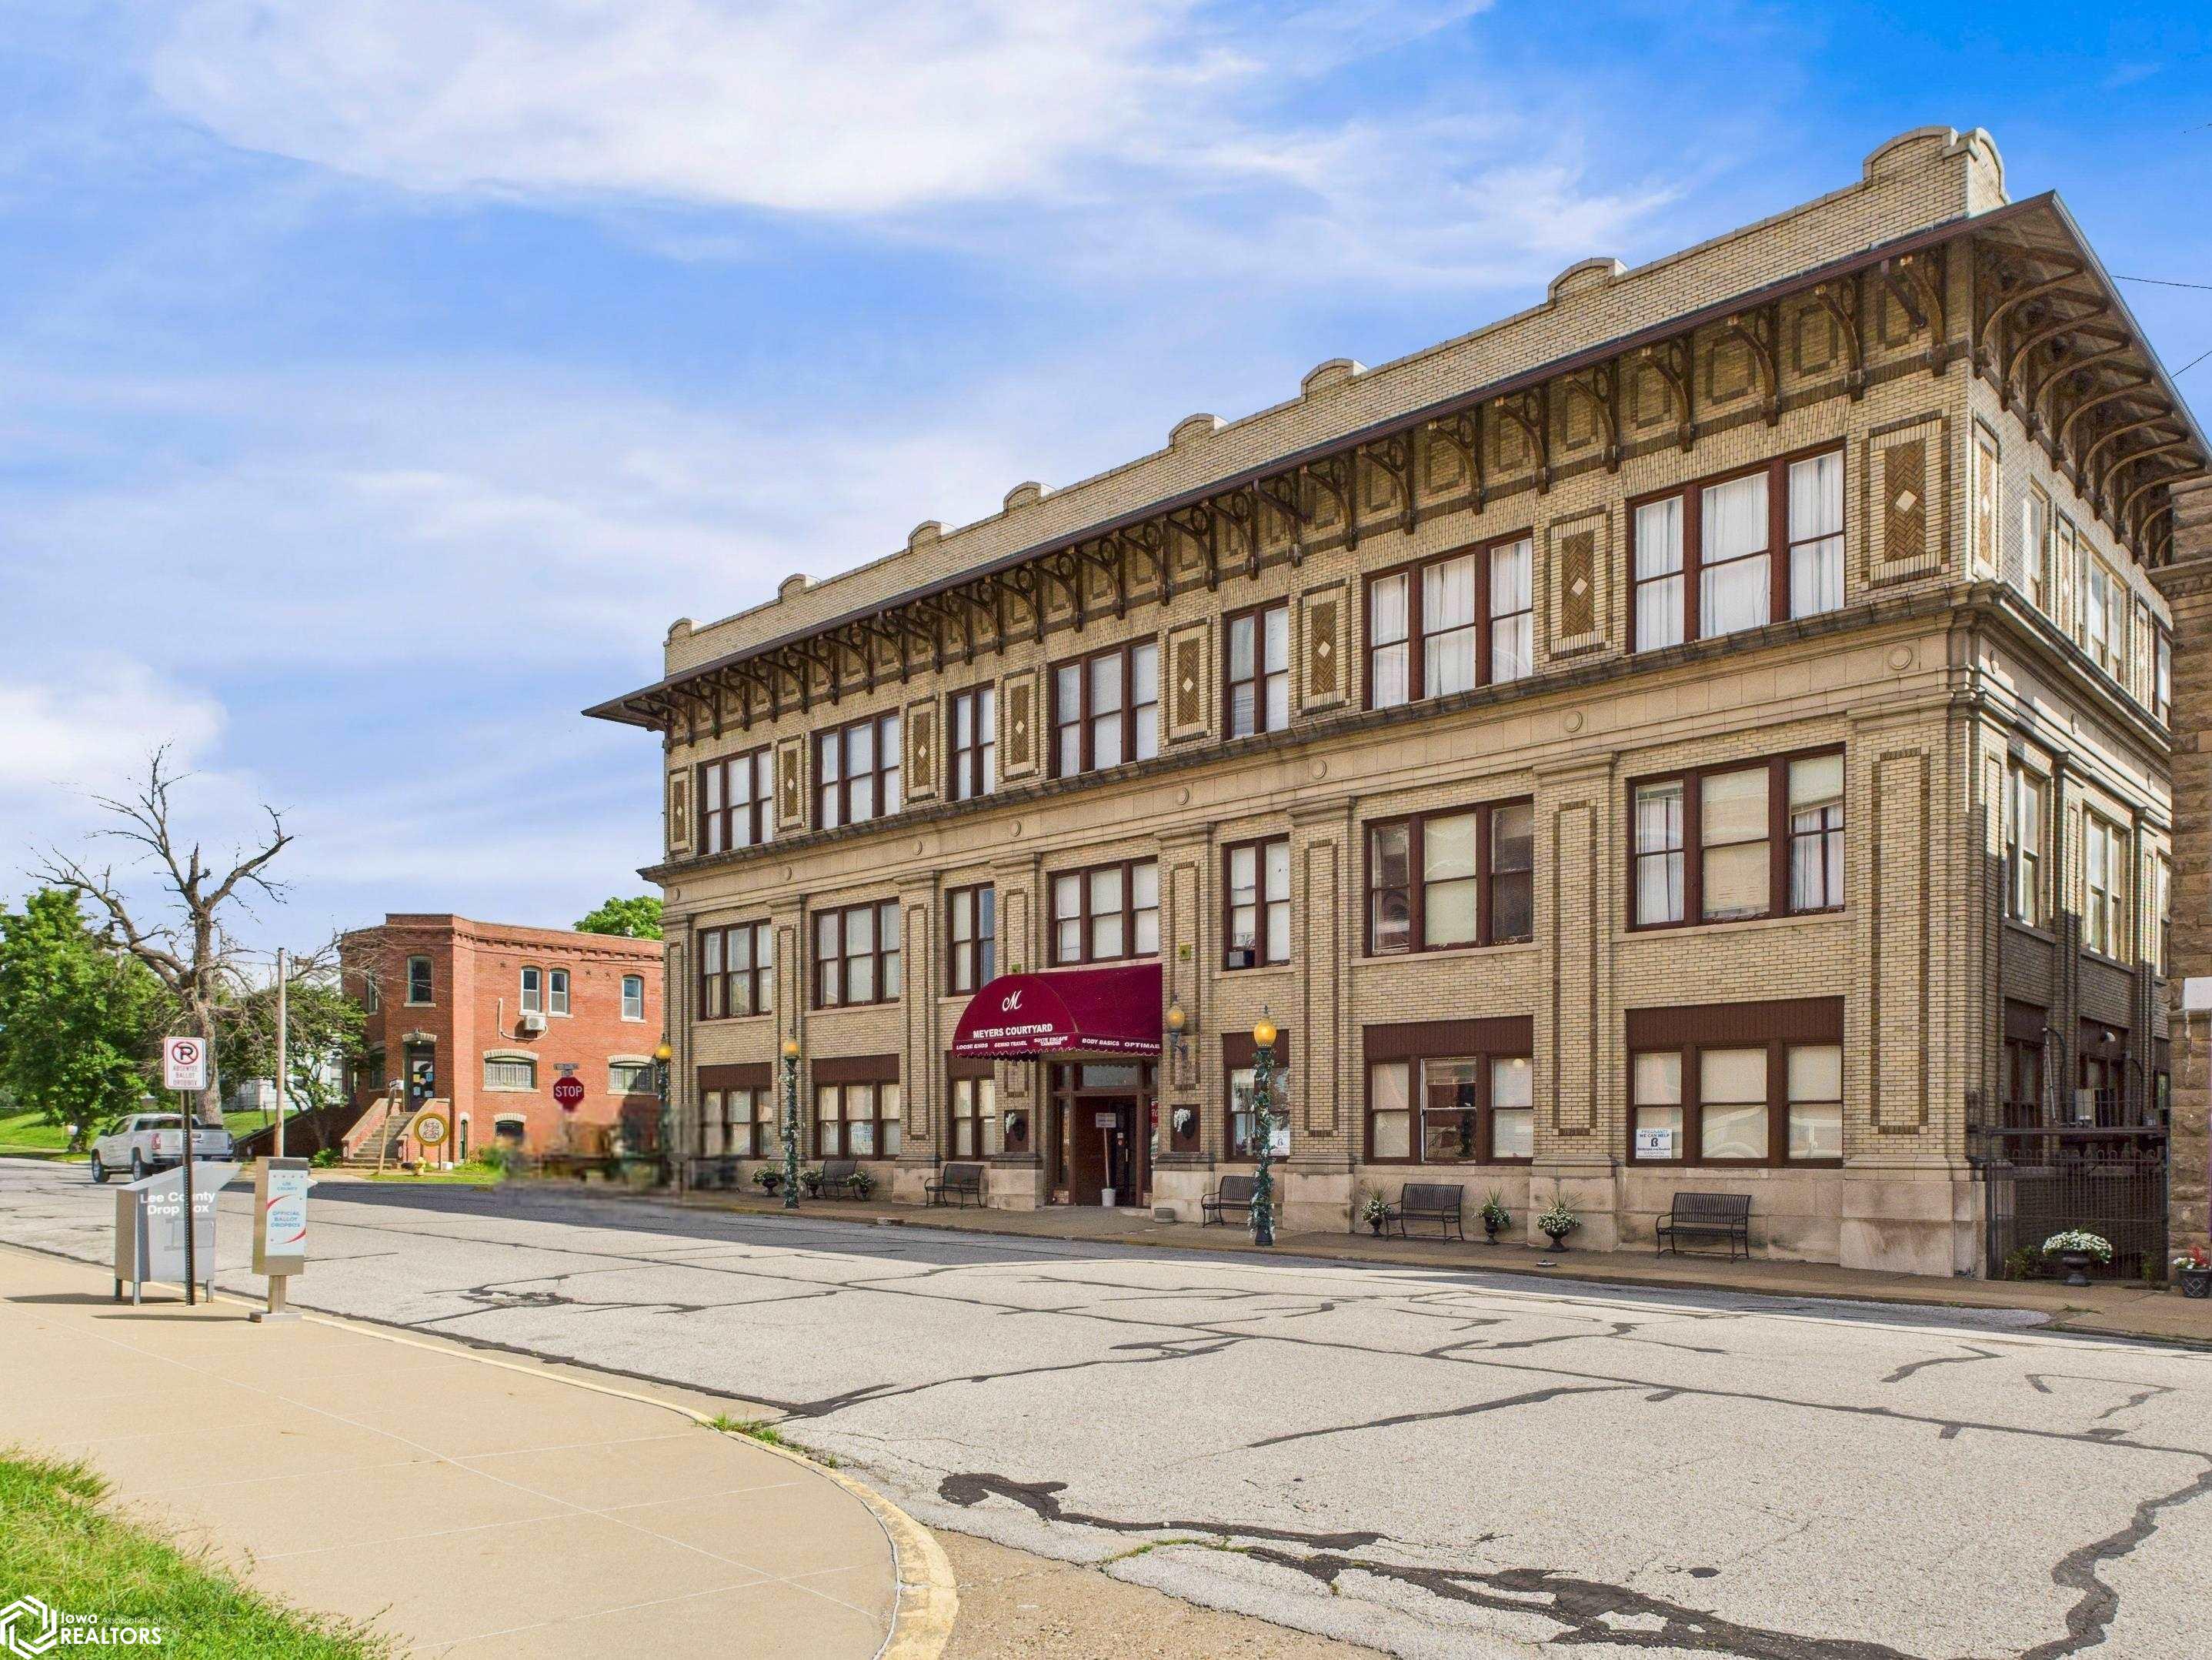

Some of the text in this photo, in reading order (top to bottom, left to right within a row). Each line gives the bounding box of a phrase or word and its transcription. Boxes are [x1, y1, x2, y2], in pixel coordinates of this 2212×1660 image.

[973, 1024, 1053, 1038] MEYERS COURTYARD
[555, 1086, 582, 1097] STOP
[140, 1192, 215, 1204] Lee Conty
[147, 1205, 179, 1216] Drop
